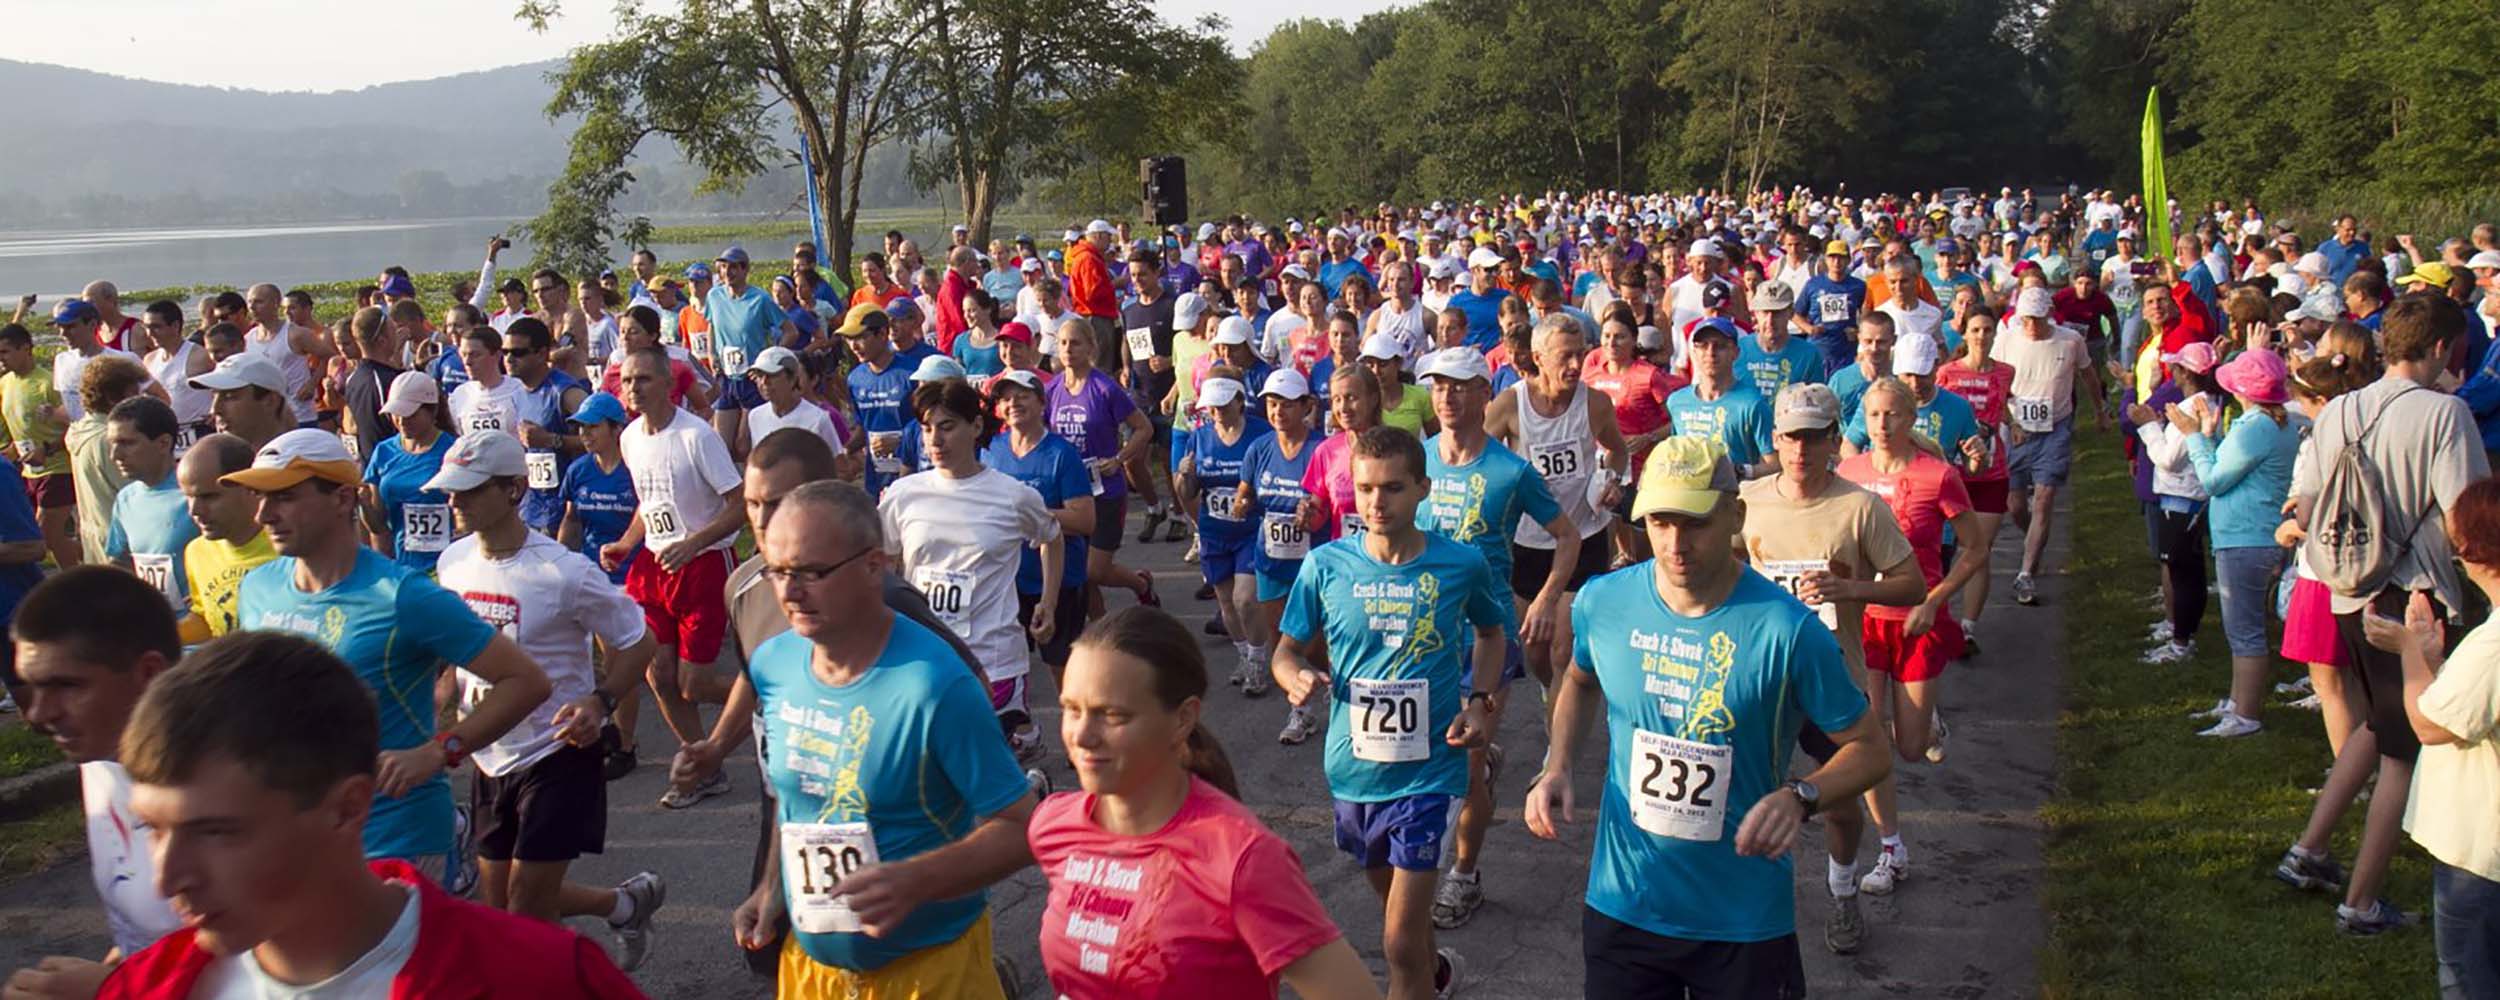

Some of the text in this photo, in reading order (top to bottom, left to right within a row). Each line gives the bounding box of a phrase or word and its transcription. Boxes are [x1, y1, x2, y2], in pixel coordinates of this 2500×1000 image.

[1824, 299, 1845, 312] 602
[2022, 404, 2049, 420] 108
[528, 463, 552, 482] 705
[1538, 450, 1577, 477] 363
[1211, 495, 1236, 515] 64
[409, 513, 443, 535] 552
[645, 511, 675, 534] 160
[2319, 526, 2374, 547] addas
[922, 582, 961, 613] 700
[465, 599, 517, 621] NKERS
[1645, 673, 1691, 701] Marathon
[1360, 696, 1417, 733] 720
[1659, 697, 1684, 719] Team
[1641, 752, 1716, 807] 232
